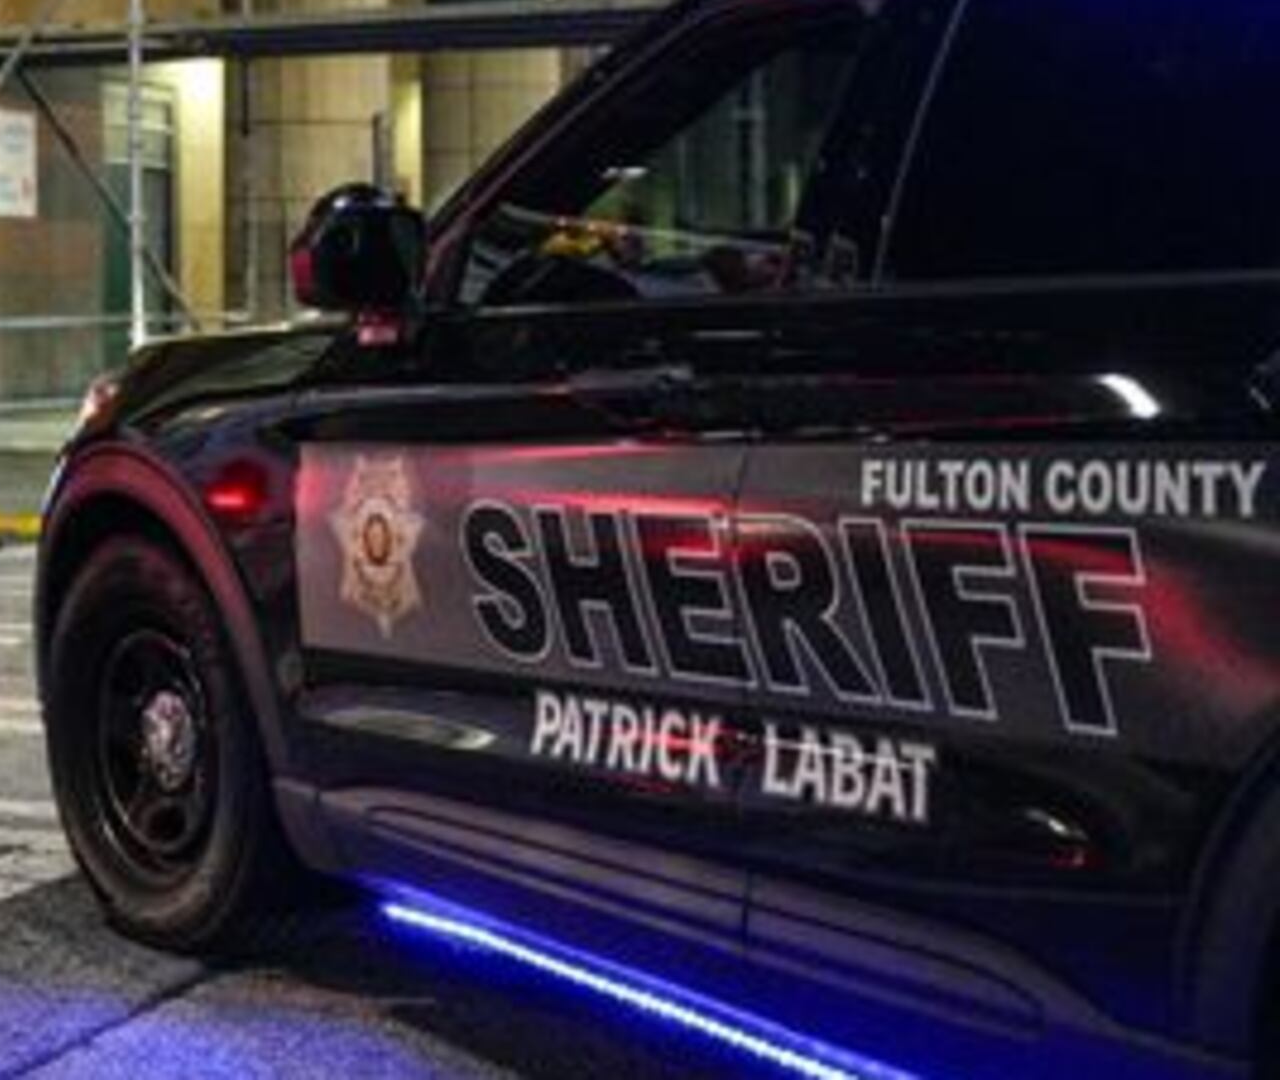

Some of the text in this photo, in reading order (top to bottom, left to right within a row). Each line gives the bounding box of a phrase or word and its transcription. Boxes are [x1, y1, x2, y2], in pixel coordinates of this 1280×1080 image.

[860, 457, 1265, 518] FULTON COUNTY
[460, 499, 1152, 736] SHERIFF
[530, 691, 936, 823] PATRICK LABAT
